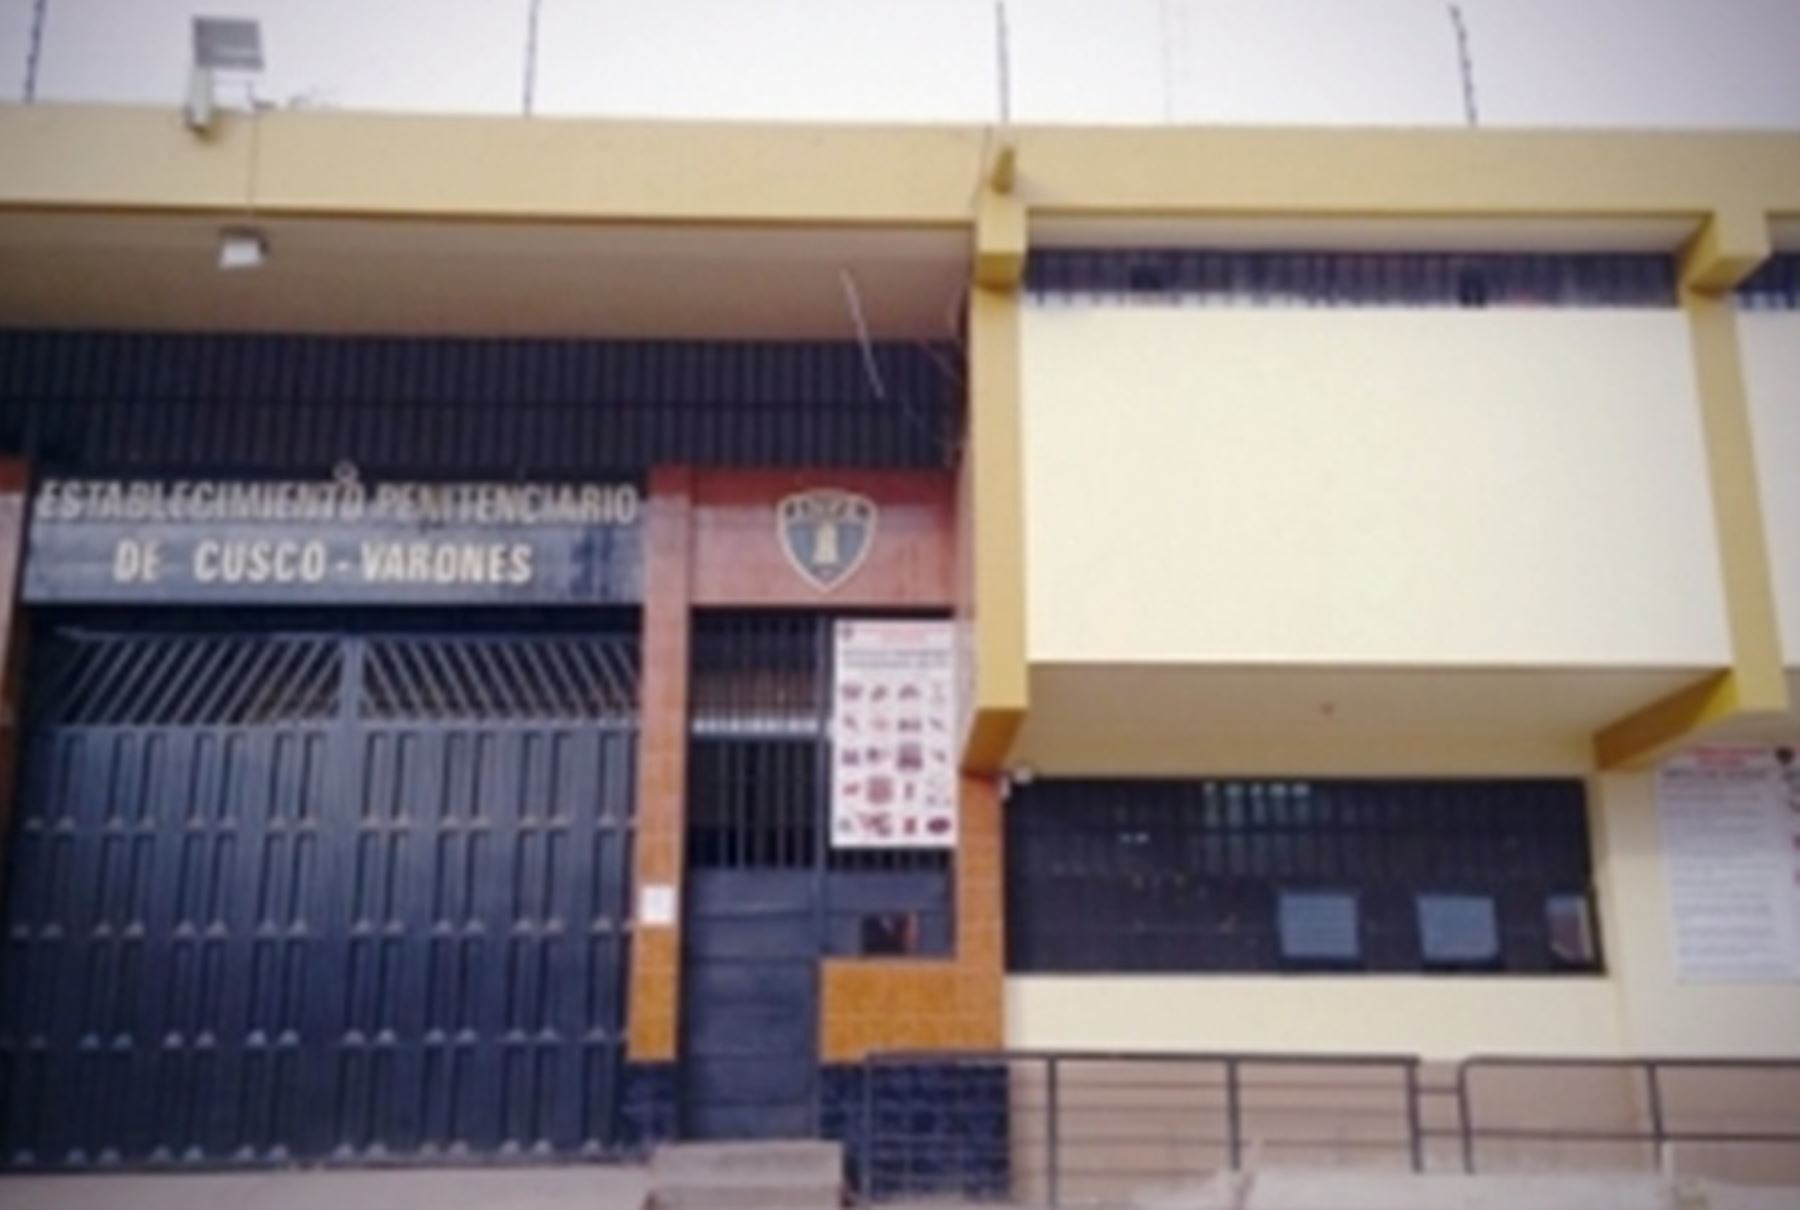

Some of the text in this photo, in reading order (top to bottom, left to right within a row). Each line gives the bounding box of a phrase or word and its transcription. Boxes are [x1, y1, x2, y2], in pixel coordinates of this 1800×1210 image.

[36, 479, 638, 523] ESTABLECIMIENTO PENITENCIARIO
[113, 540, 161, 582] DE
[193, 540, 326, 582] CUSCO
[360, 542, 533, 584] VARONES
